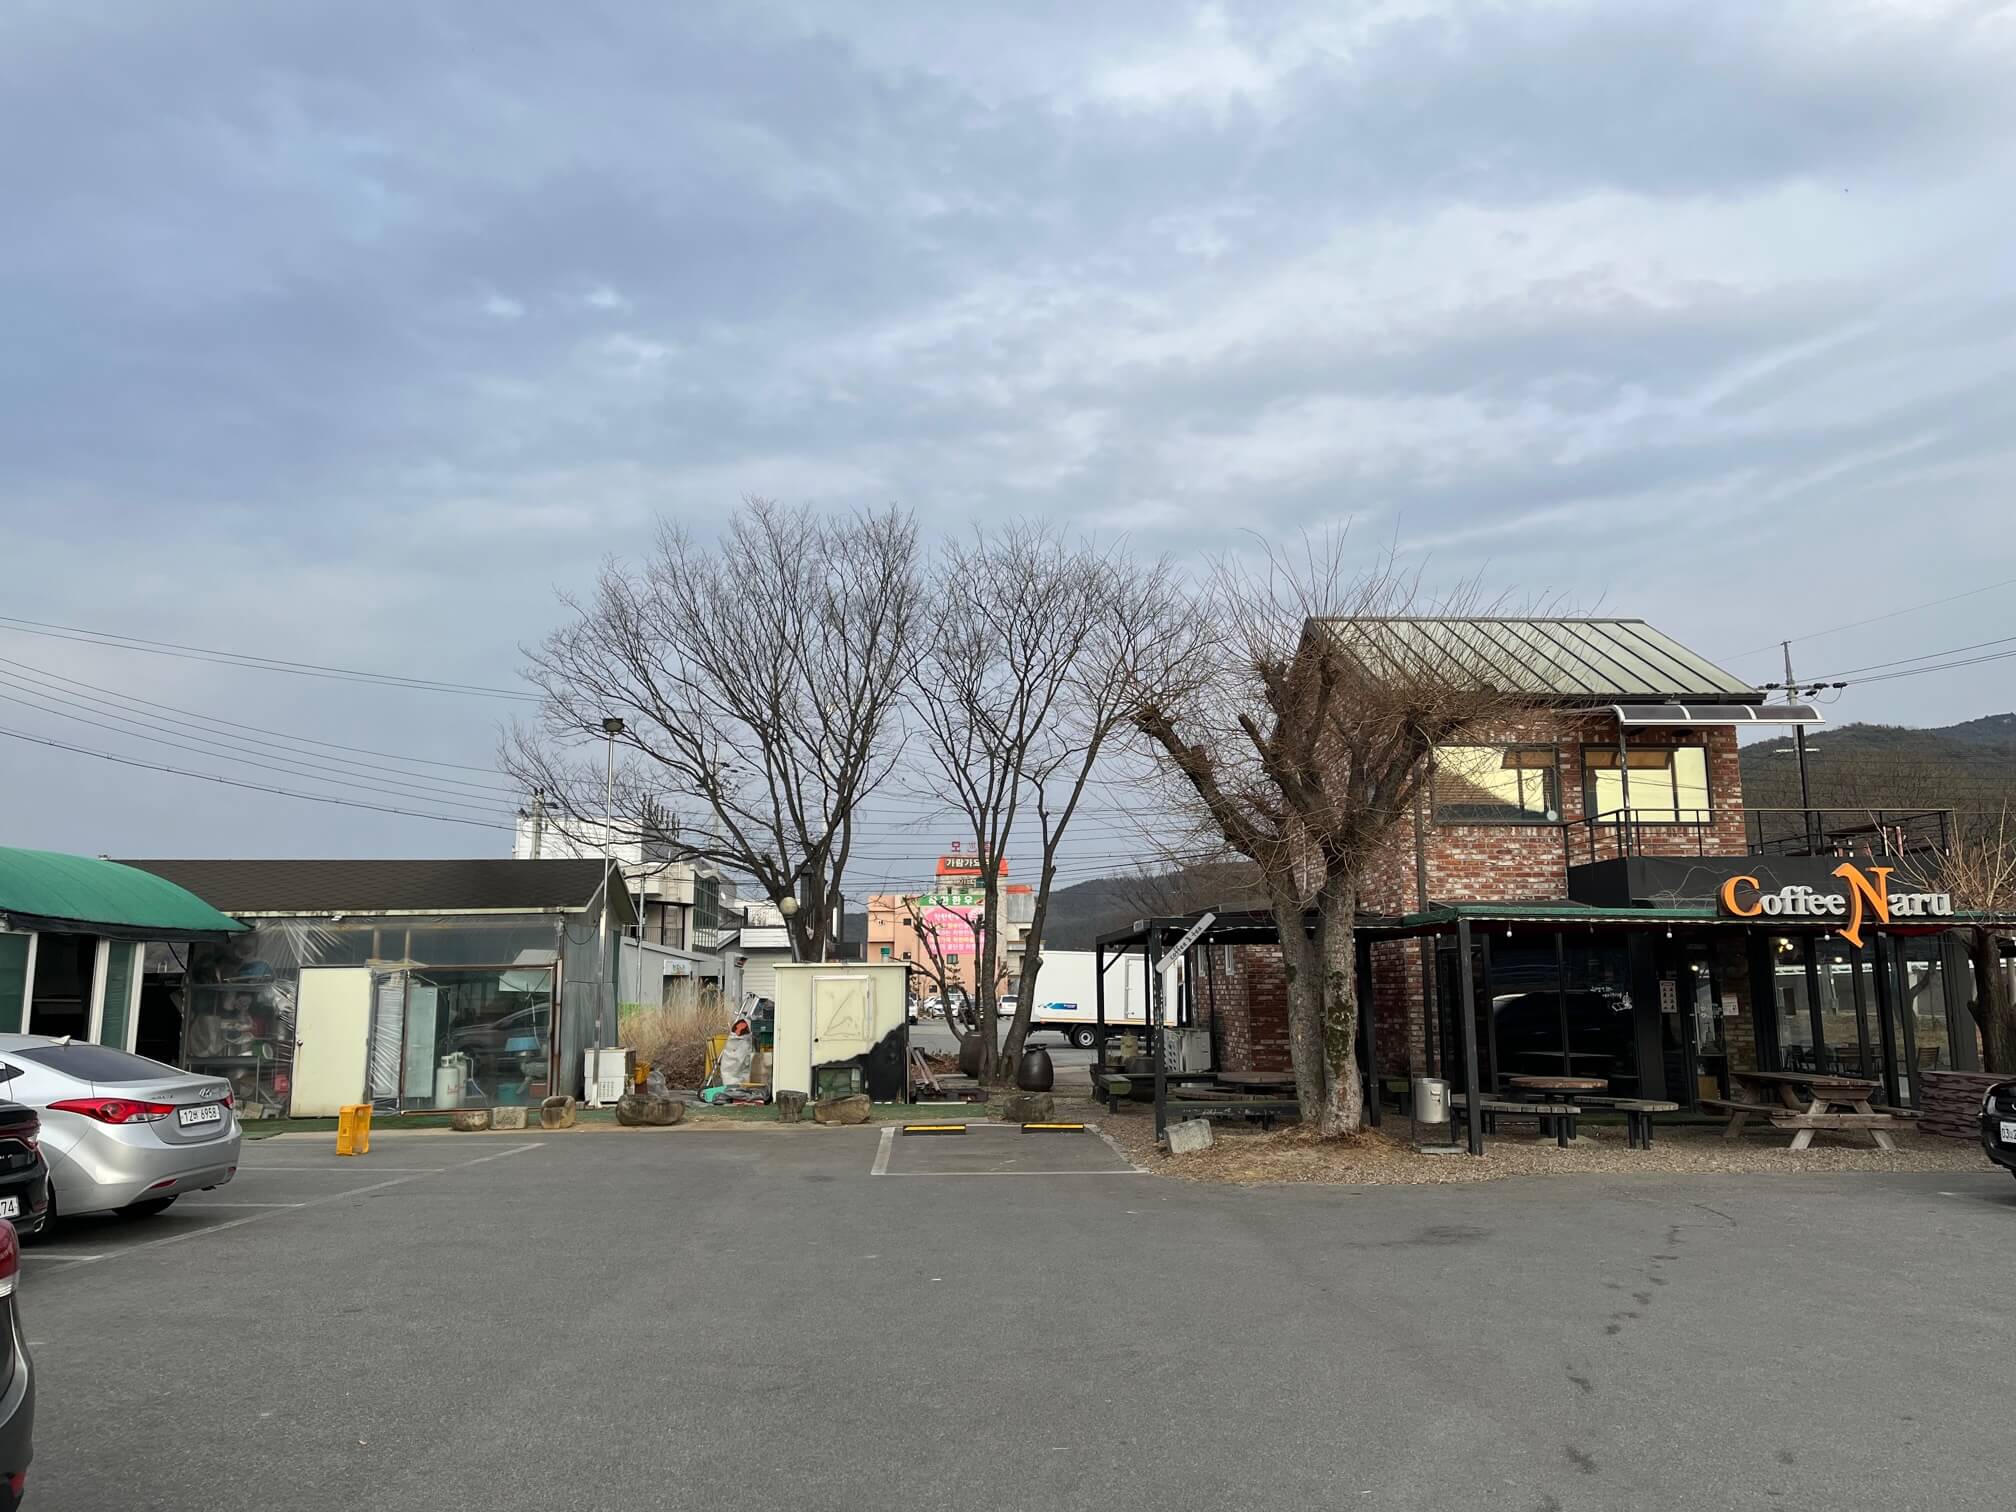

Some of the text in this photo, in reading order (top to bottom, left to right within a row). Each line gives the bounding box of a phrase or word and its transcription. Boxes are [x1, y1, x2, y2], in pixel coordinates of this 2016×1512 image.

[1721, 862, 1954, 949] Coffee Naru
[1170, 942, 1187, 960] coffee
[200, 1107, 217, 1120] 6958
